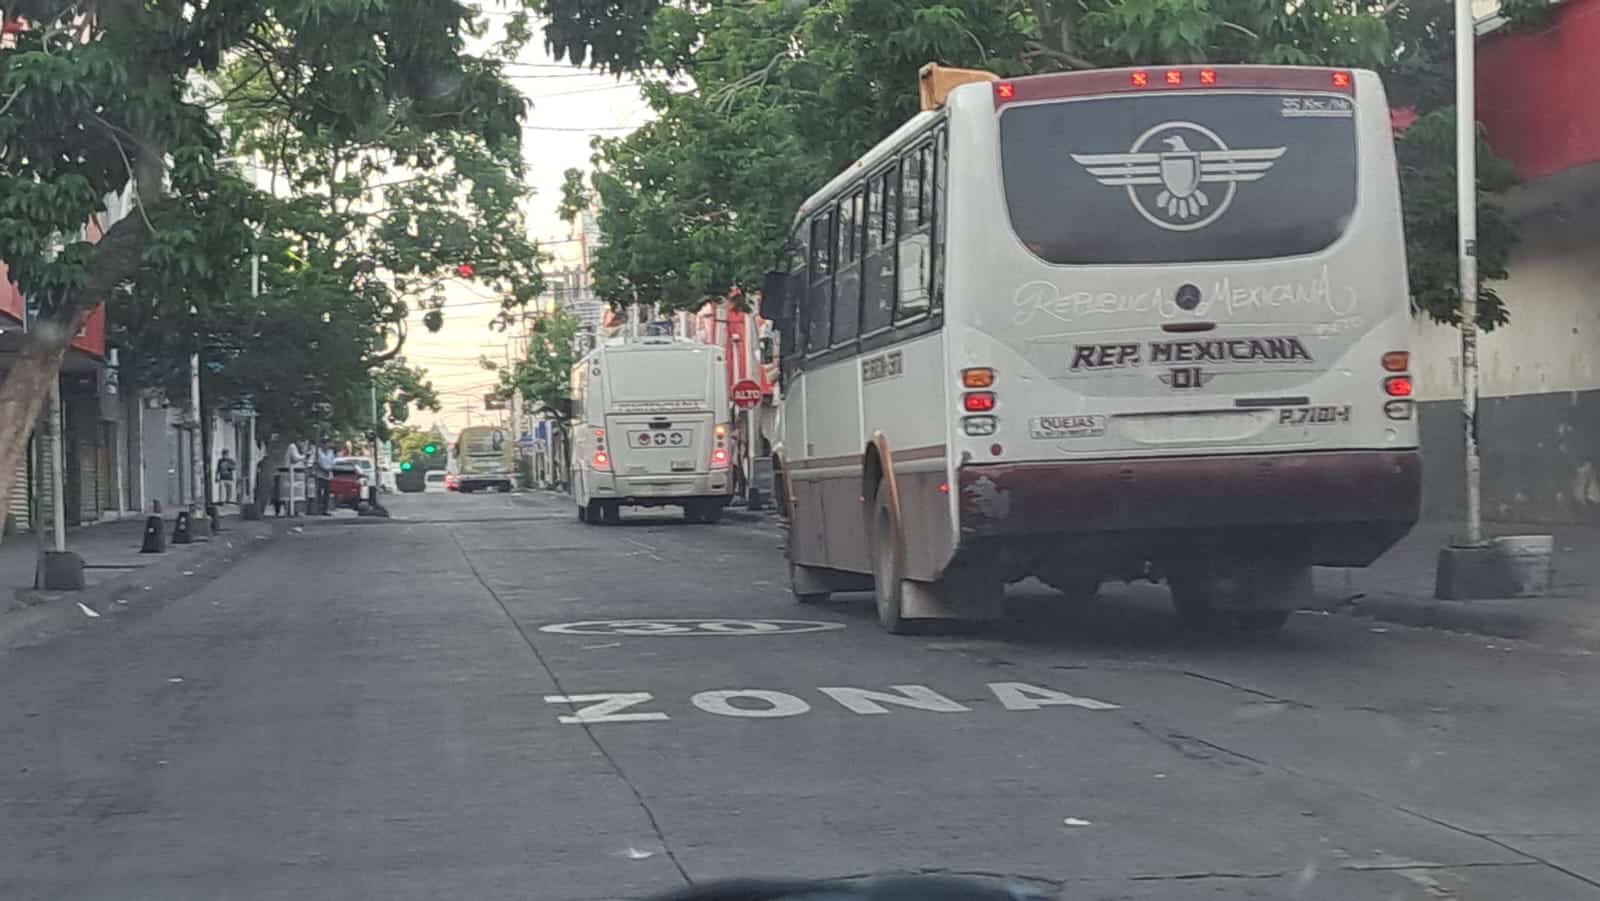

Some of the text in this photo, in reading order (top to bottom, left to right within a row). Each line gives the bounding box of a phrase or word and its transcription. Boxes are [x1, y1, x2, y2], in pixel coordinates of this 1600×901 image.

[1071, 335, 1313, 369] REP. MEXICANA
[735, 389, 761, 400] ALTO
[1040, 415, 1095, 431] QUEJAS
[543, 681, 1121, 724] ZONA
